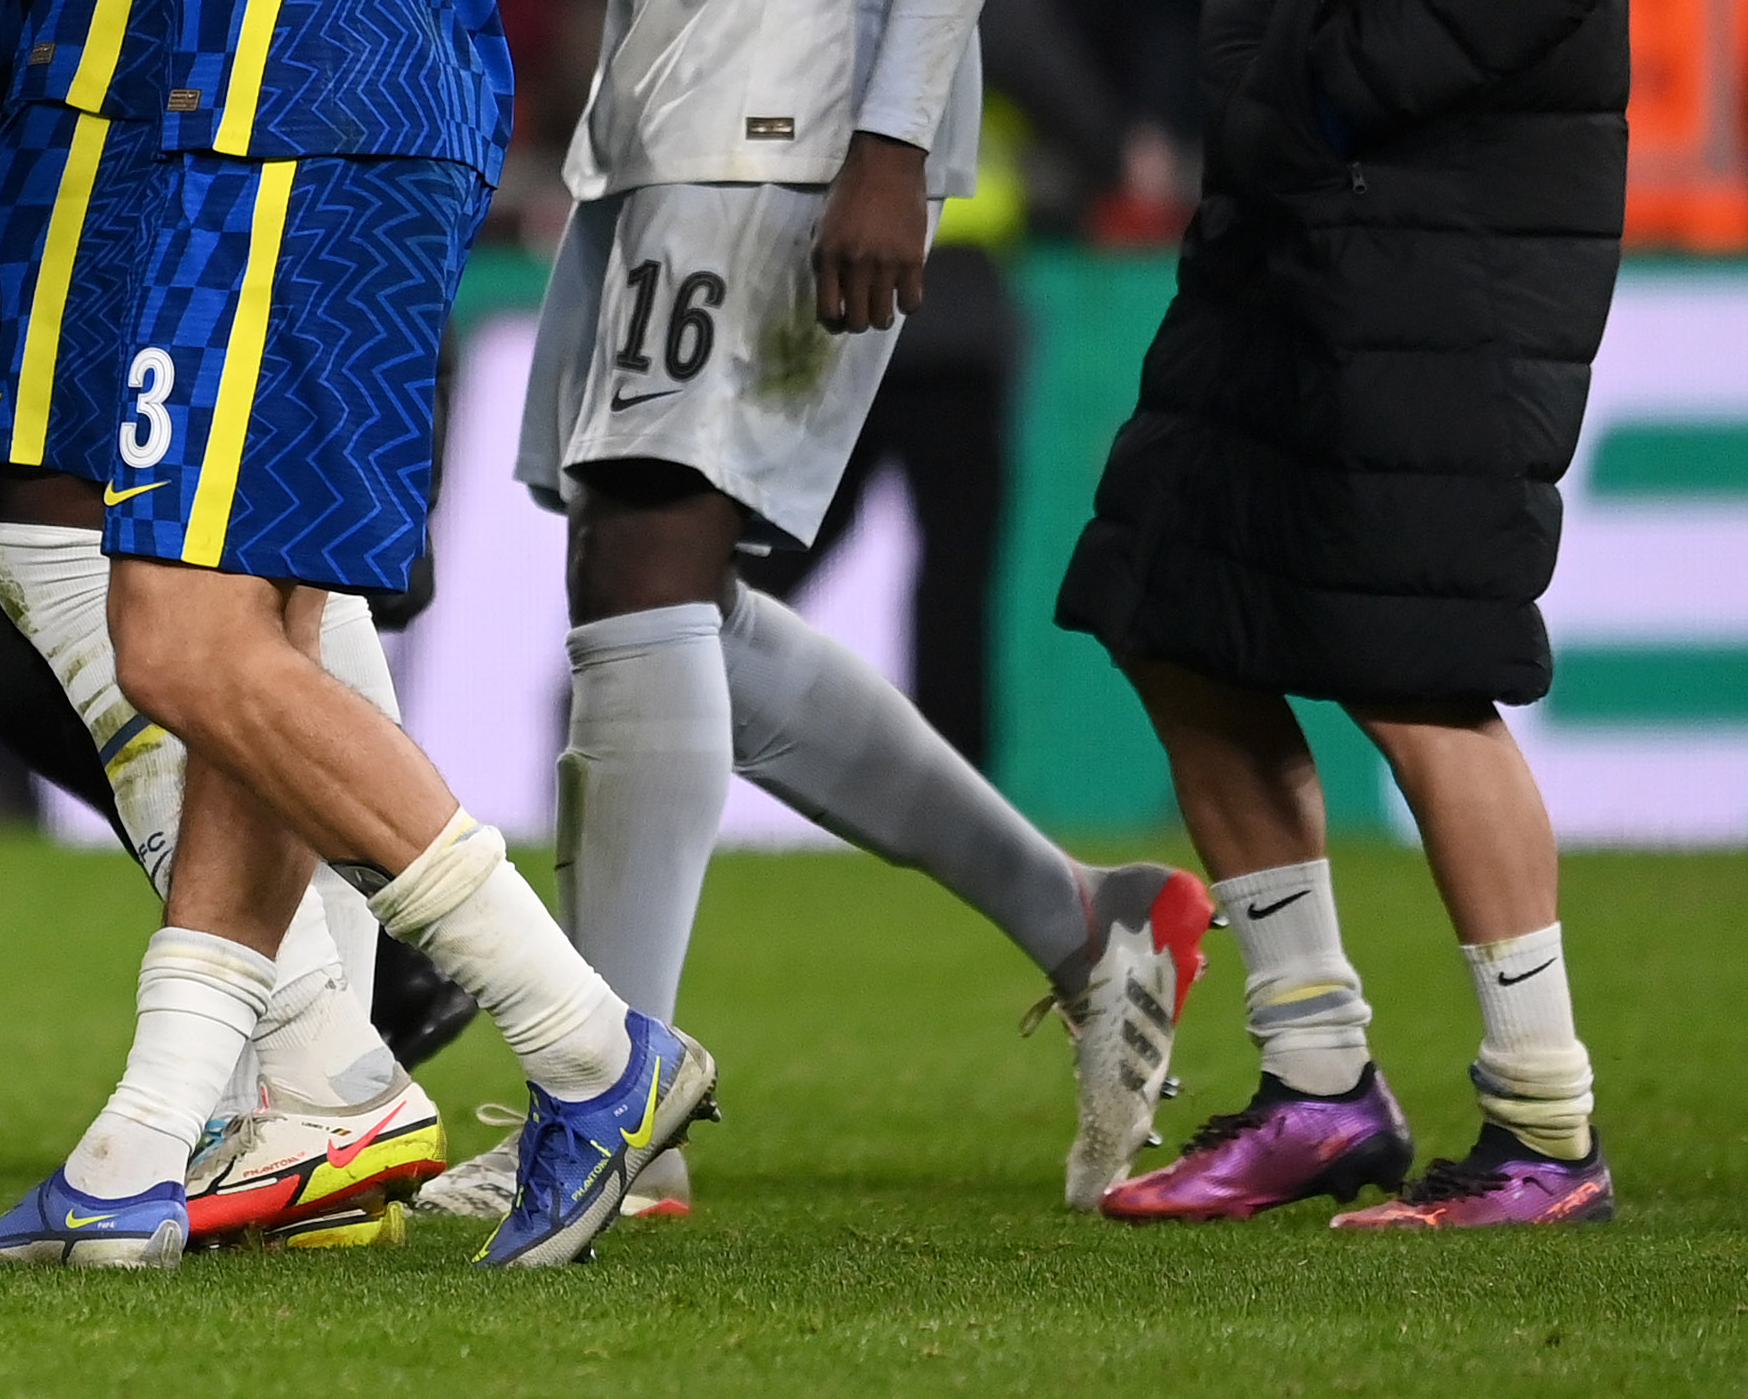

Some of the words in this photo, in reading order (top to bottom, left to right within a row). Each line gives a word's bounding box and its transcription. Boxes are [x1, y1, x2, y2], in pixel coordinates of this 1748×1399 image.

[614, 259, 727, 383] 16
[118, 347, 175, 468] 3
[139, 831, 166, 863] FC
[243, 1155, 299, 1178] PHANTOM
[570, 1158, 610, 1202] PHANTOM
